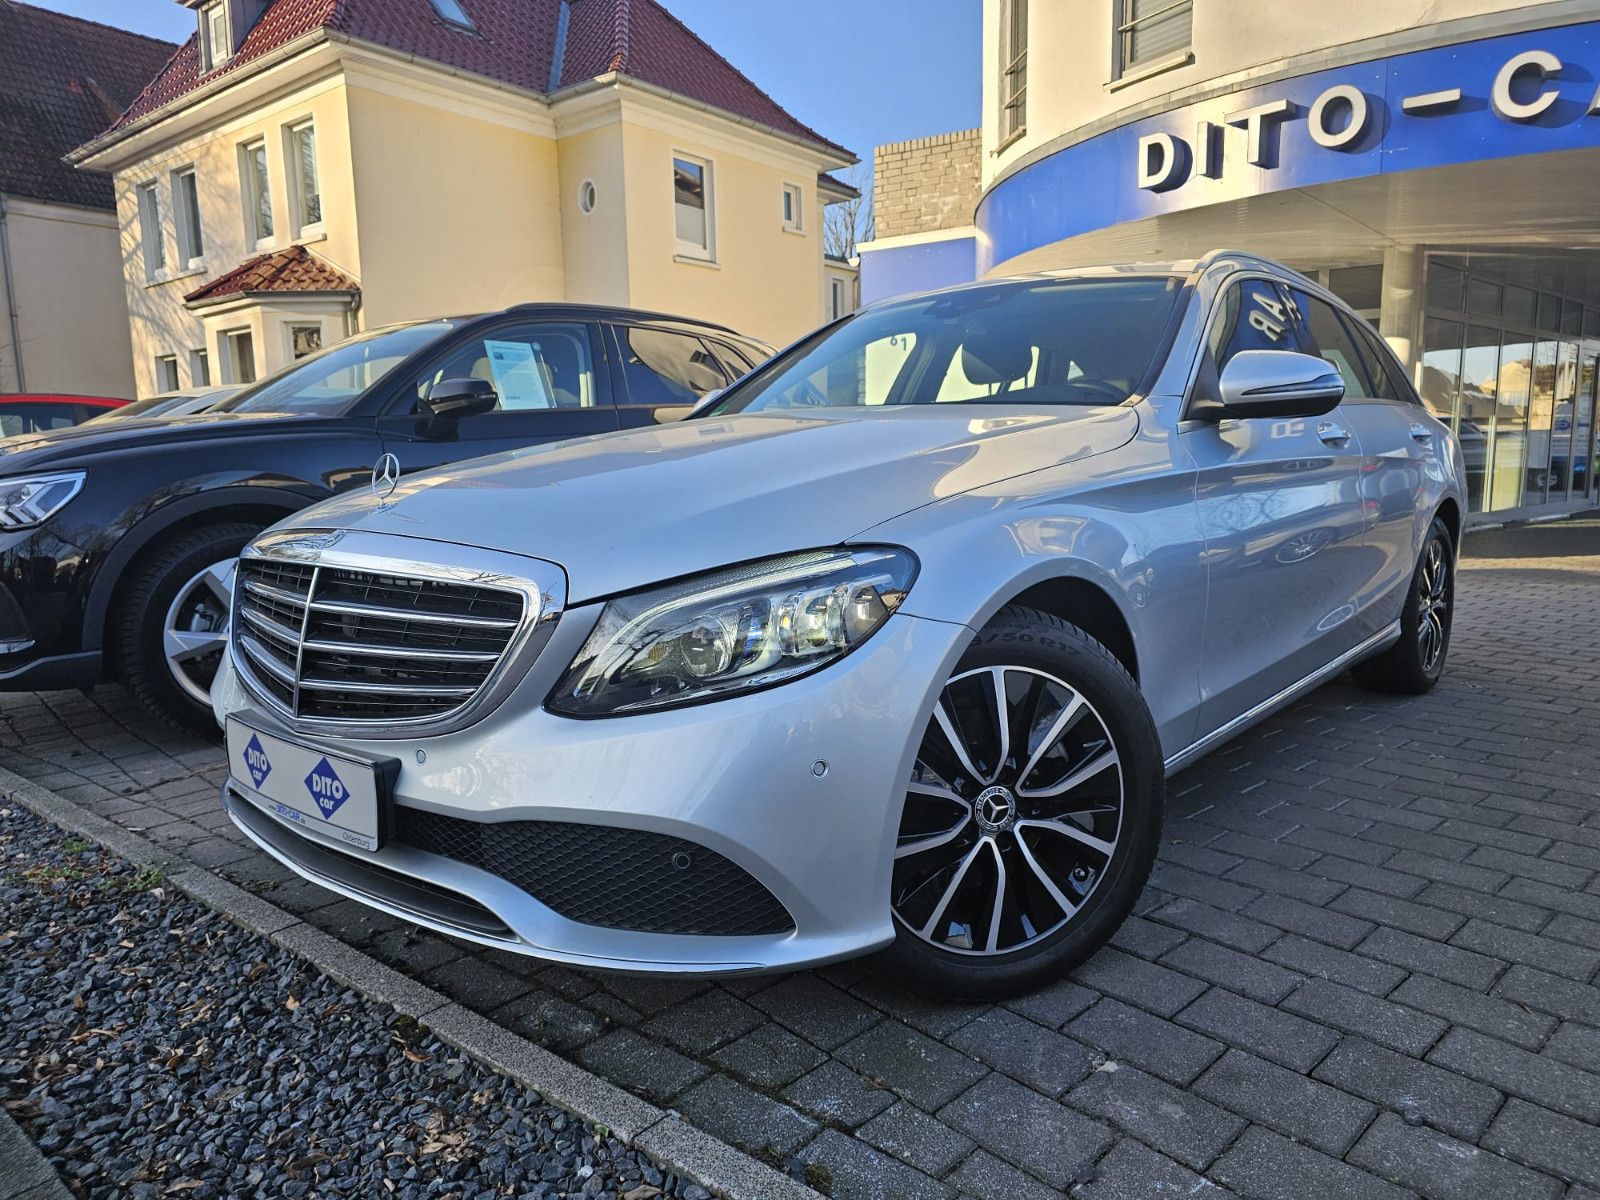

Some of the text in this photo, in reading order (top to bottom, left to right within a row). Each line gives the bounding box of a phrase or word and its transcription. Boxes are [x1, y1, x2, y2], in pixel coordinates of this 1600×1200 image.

[1138, 84, 1368, 193] DITO
[247, 746, 268, 772] DITO
[312, 773, 344, 800] DITO
[319, 797, 335, 810] car
